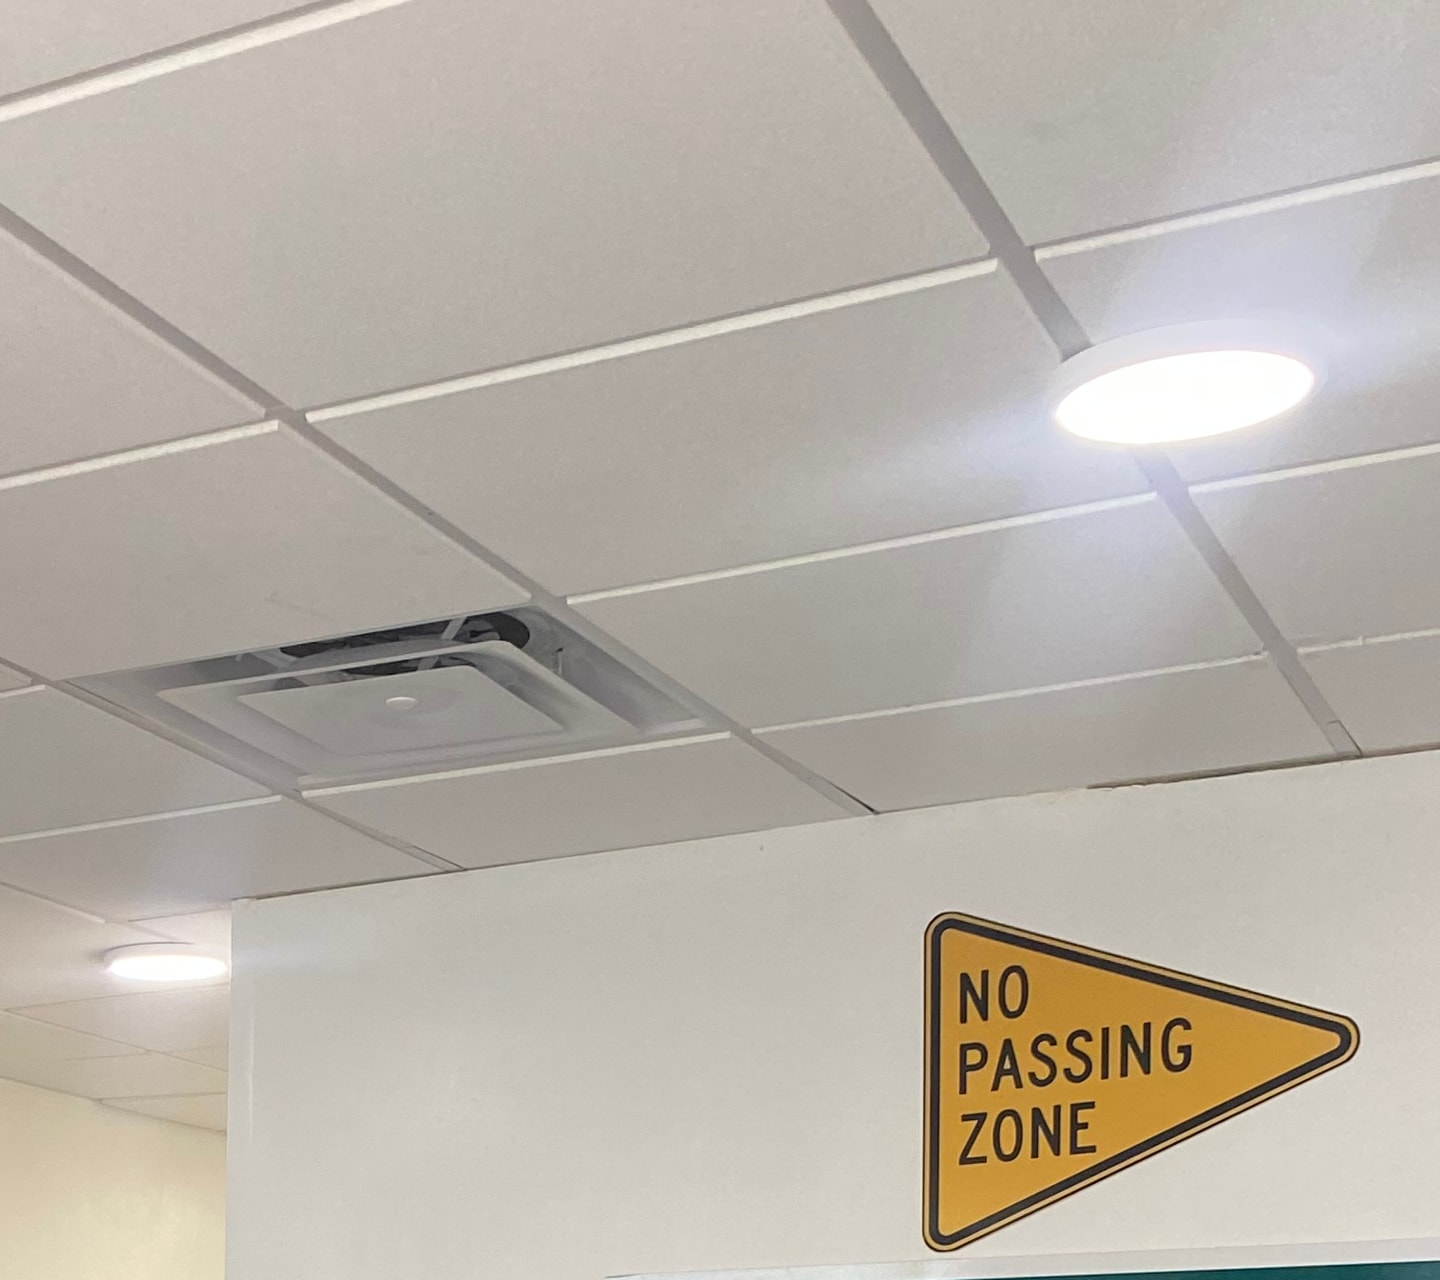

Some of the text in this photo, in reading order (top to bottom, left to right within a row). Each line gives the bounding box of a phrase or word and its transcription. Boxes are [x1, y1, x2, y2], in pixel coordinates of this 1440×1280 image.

[959, 964, 1030, 1024] NO
[958, 1016, 1193, 1095] PASSING
[958, 1101, 1097, 1165] ZONE
